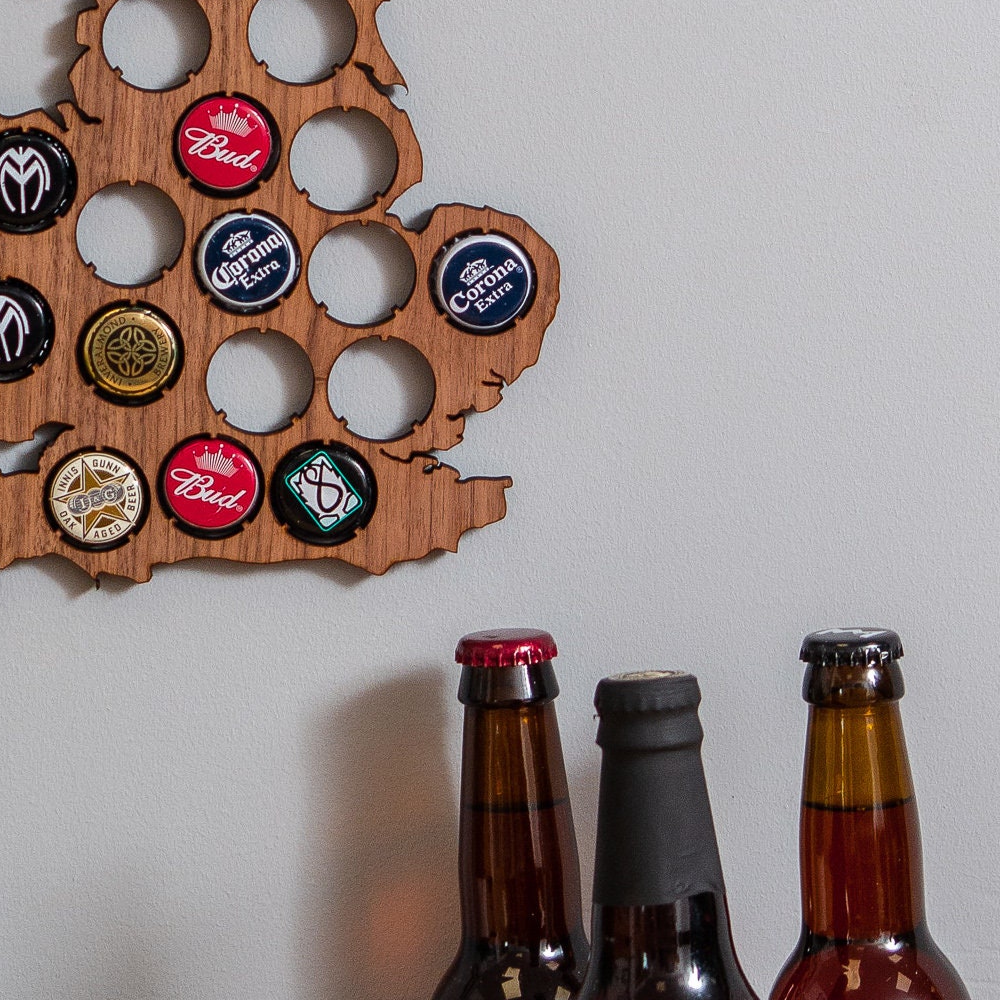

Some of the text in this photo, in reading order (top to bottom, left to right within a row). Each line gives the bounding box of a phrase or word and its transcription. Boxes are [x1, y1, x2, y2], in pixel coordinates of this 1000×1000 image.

[184, 126, 262, 169] Bud
[211, 233, 284, 291] Corona
[238, 260, 281, 291] Extra
[449, 256, 518, 314] Corona
[474, 280, 514, 313] Extra
[95, 316, 127, 386] INVERALMOND
[152, 328, 169, 377] BREWERY
[58, 459, 121, 492] INNIS GUNN
[170, 467, 247, 510] Bud
[59, 484, 137, 539] OAK AGED BEER
